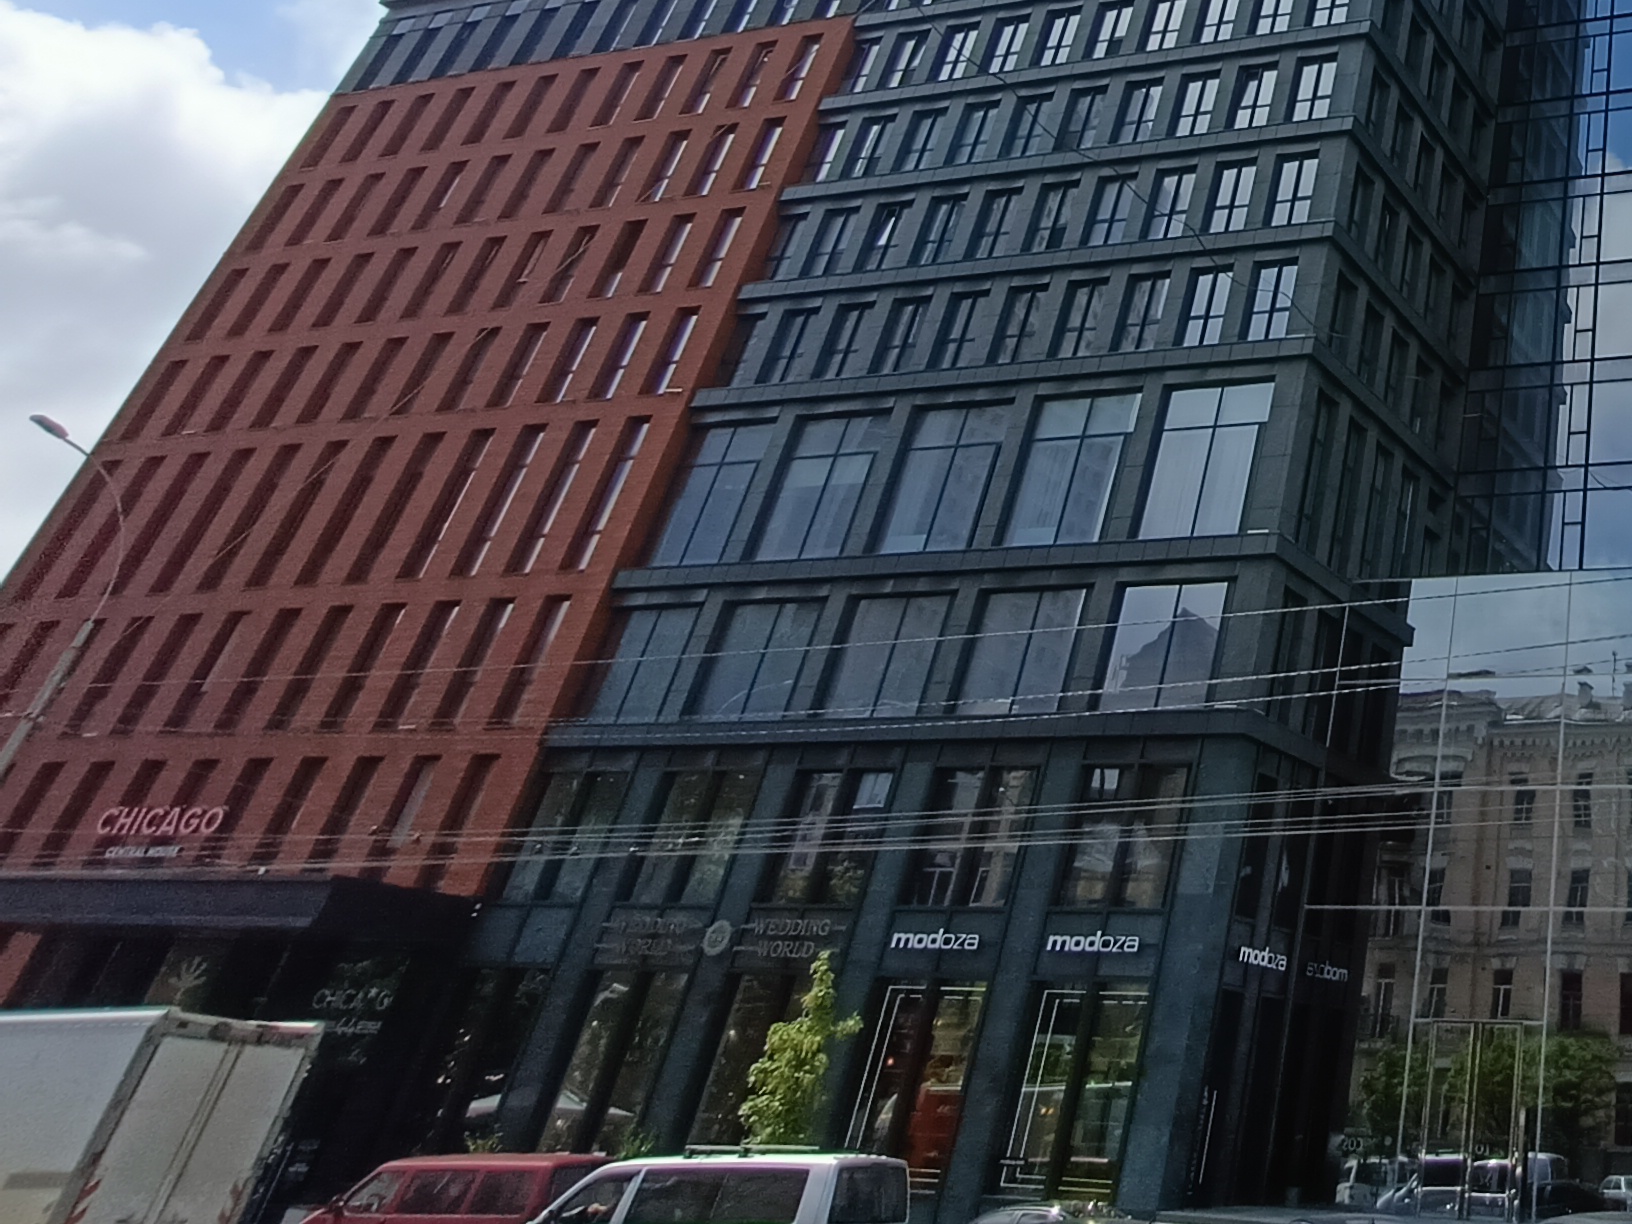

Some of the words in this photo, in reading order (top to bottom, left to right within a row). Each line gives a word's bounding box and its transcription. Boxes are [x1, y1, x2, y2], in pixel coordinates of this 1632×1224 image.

[97, 805, 226, 836] CHICAGO
[753, 917, 832, 936] WEDDING
[757, 940, 815, 958] WORLD
[890, 928, 980, 952] modoza
[1046, 930, 1139, 954] modoza
[1239, 945, 1288, 971] modoza
